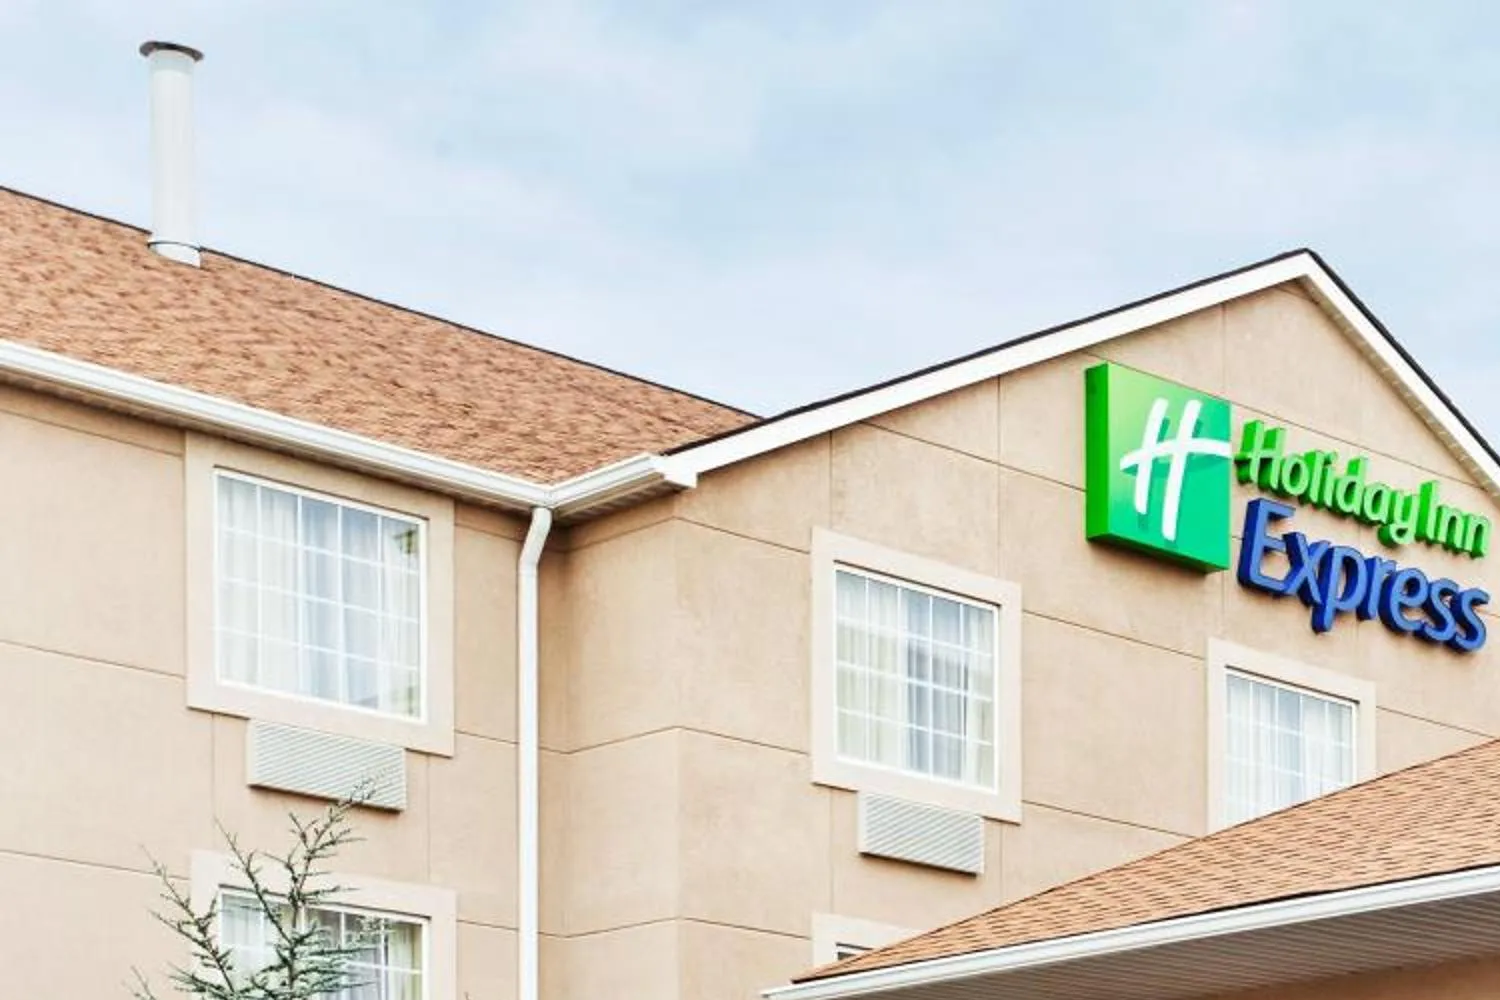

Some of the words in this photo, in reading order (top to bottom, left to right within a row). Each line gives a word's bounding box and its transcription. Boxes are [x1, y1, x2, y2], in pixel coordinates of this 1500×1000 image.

[1235, 420, 1416, 546] Holiday
[1416, 480, 1490, 558] Inn
[1238, 498, 1490, 652] Express
